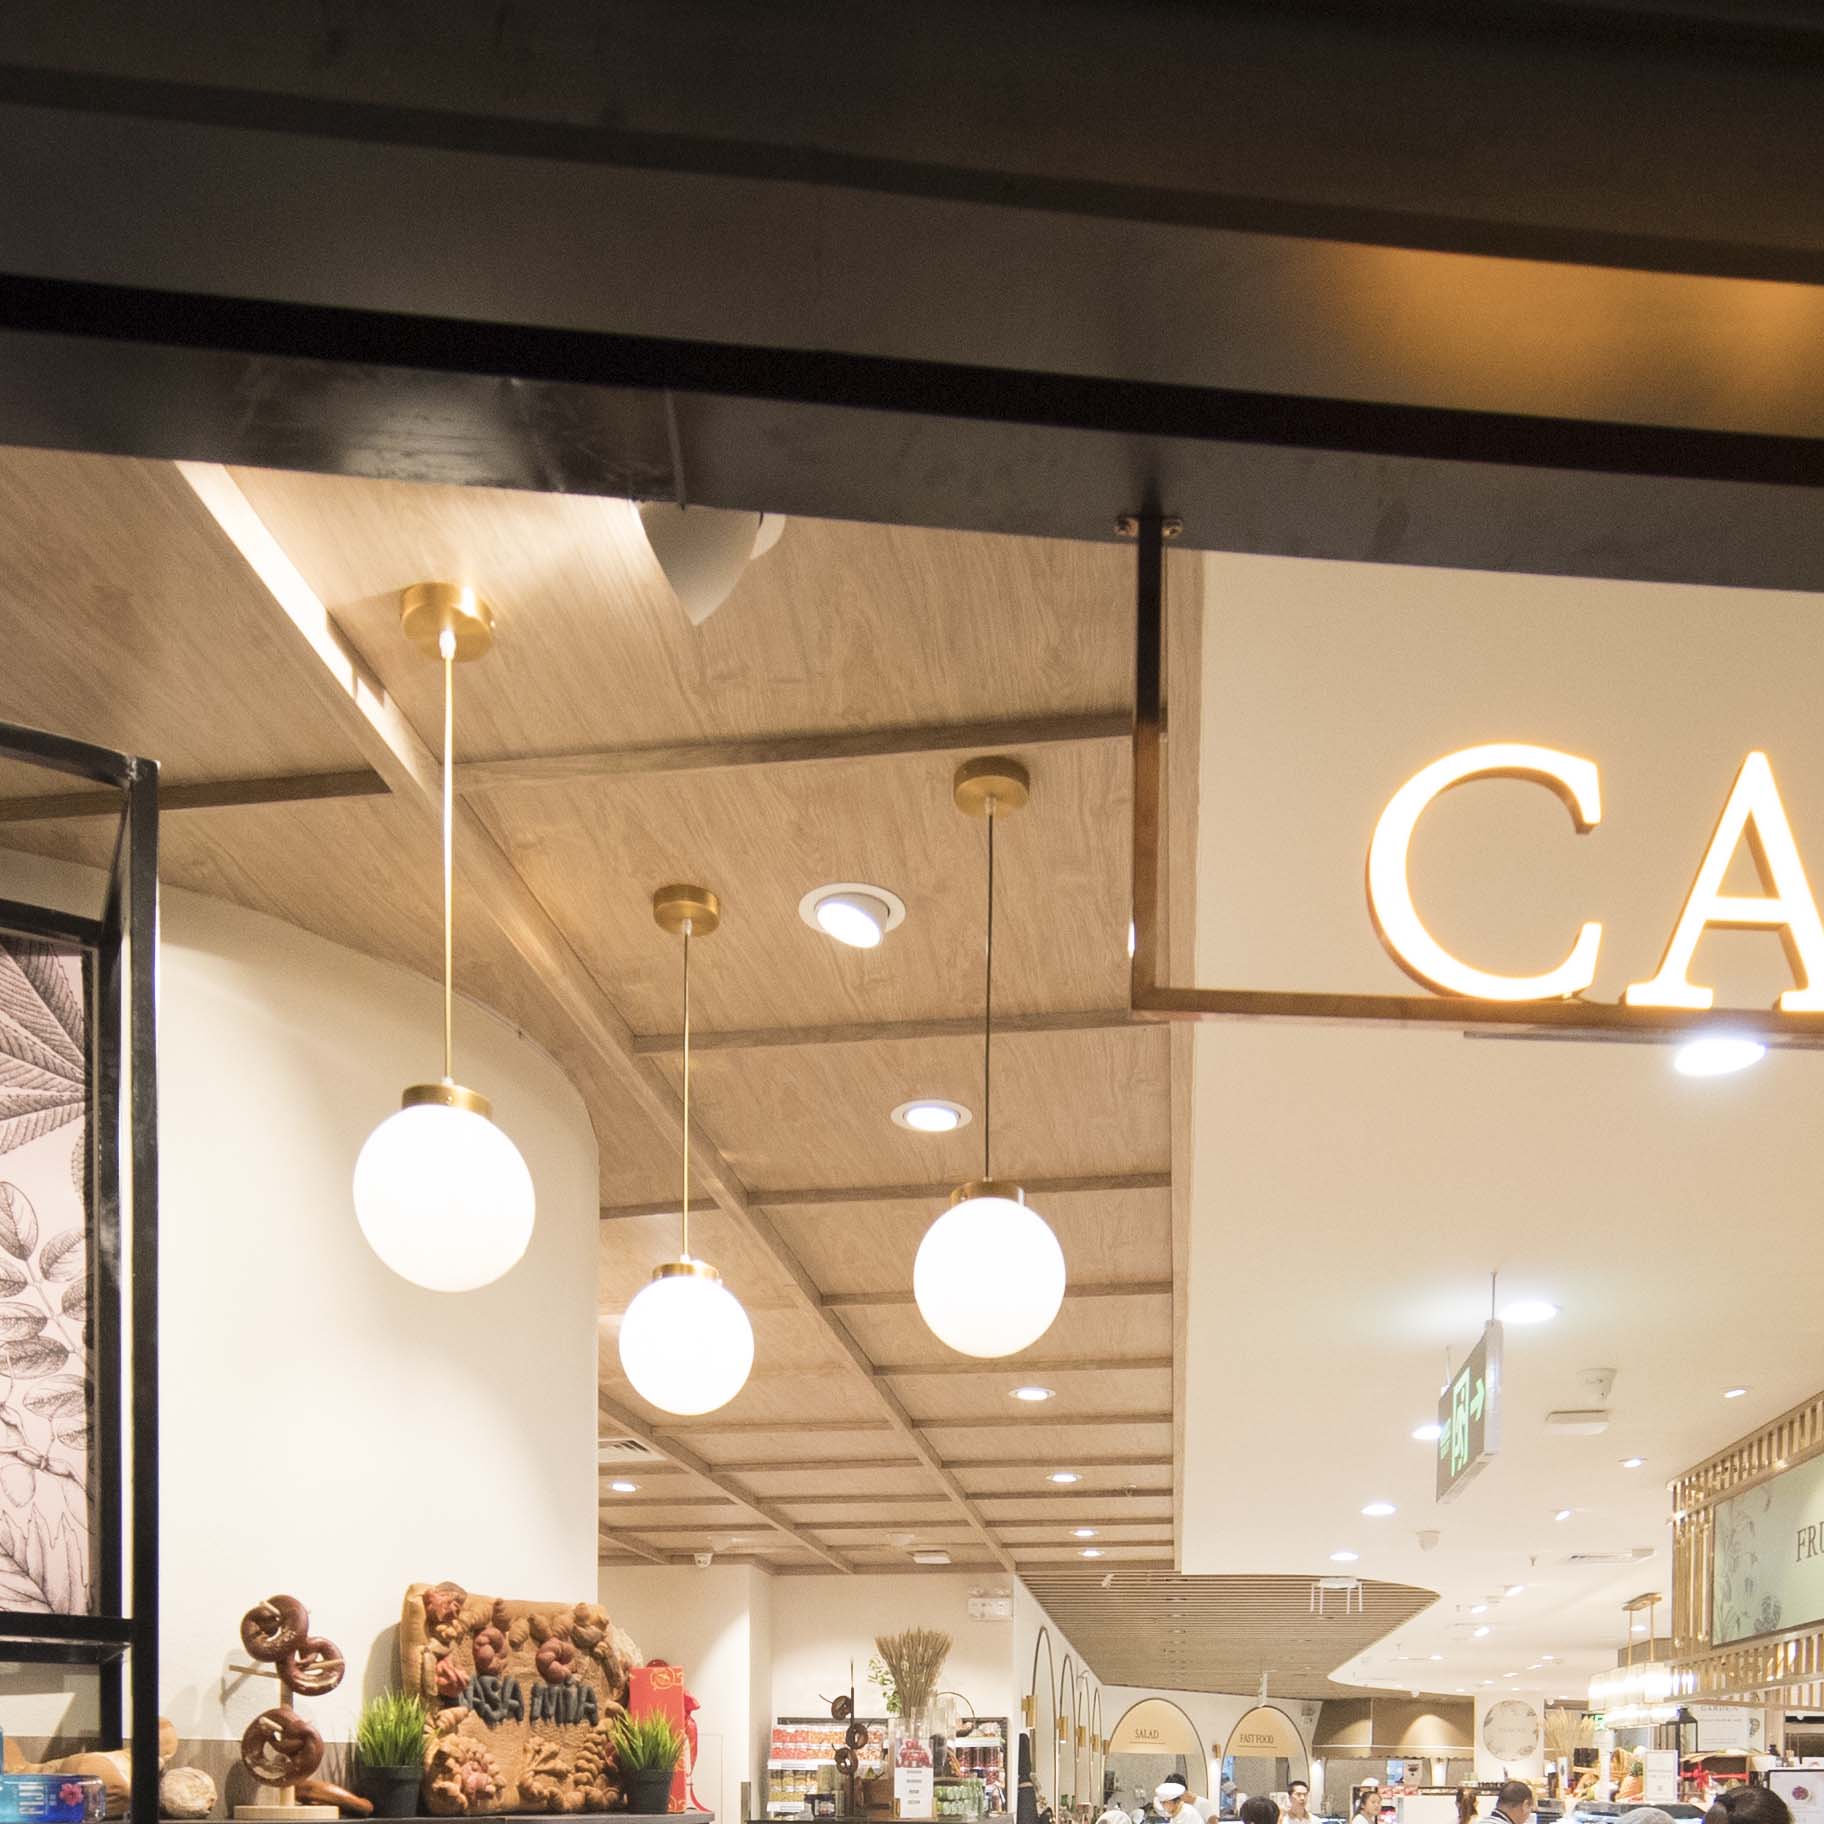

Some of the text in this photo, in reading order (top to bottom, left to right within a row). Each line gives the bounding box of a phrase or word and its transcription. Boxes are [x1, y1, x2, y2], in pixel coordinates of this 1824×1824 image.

[459, 1675, 523, 1729] ASA
[1135, 1728, 1161, 1739] SALAD
[1239, 1733, 1274, 1744] FAST FOOD
[18, 1783, 45, 1816] FIJI
